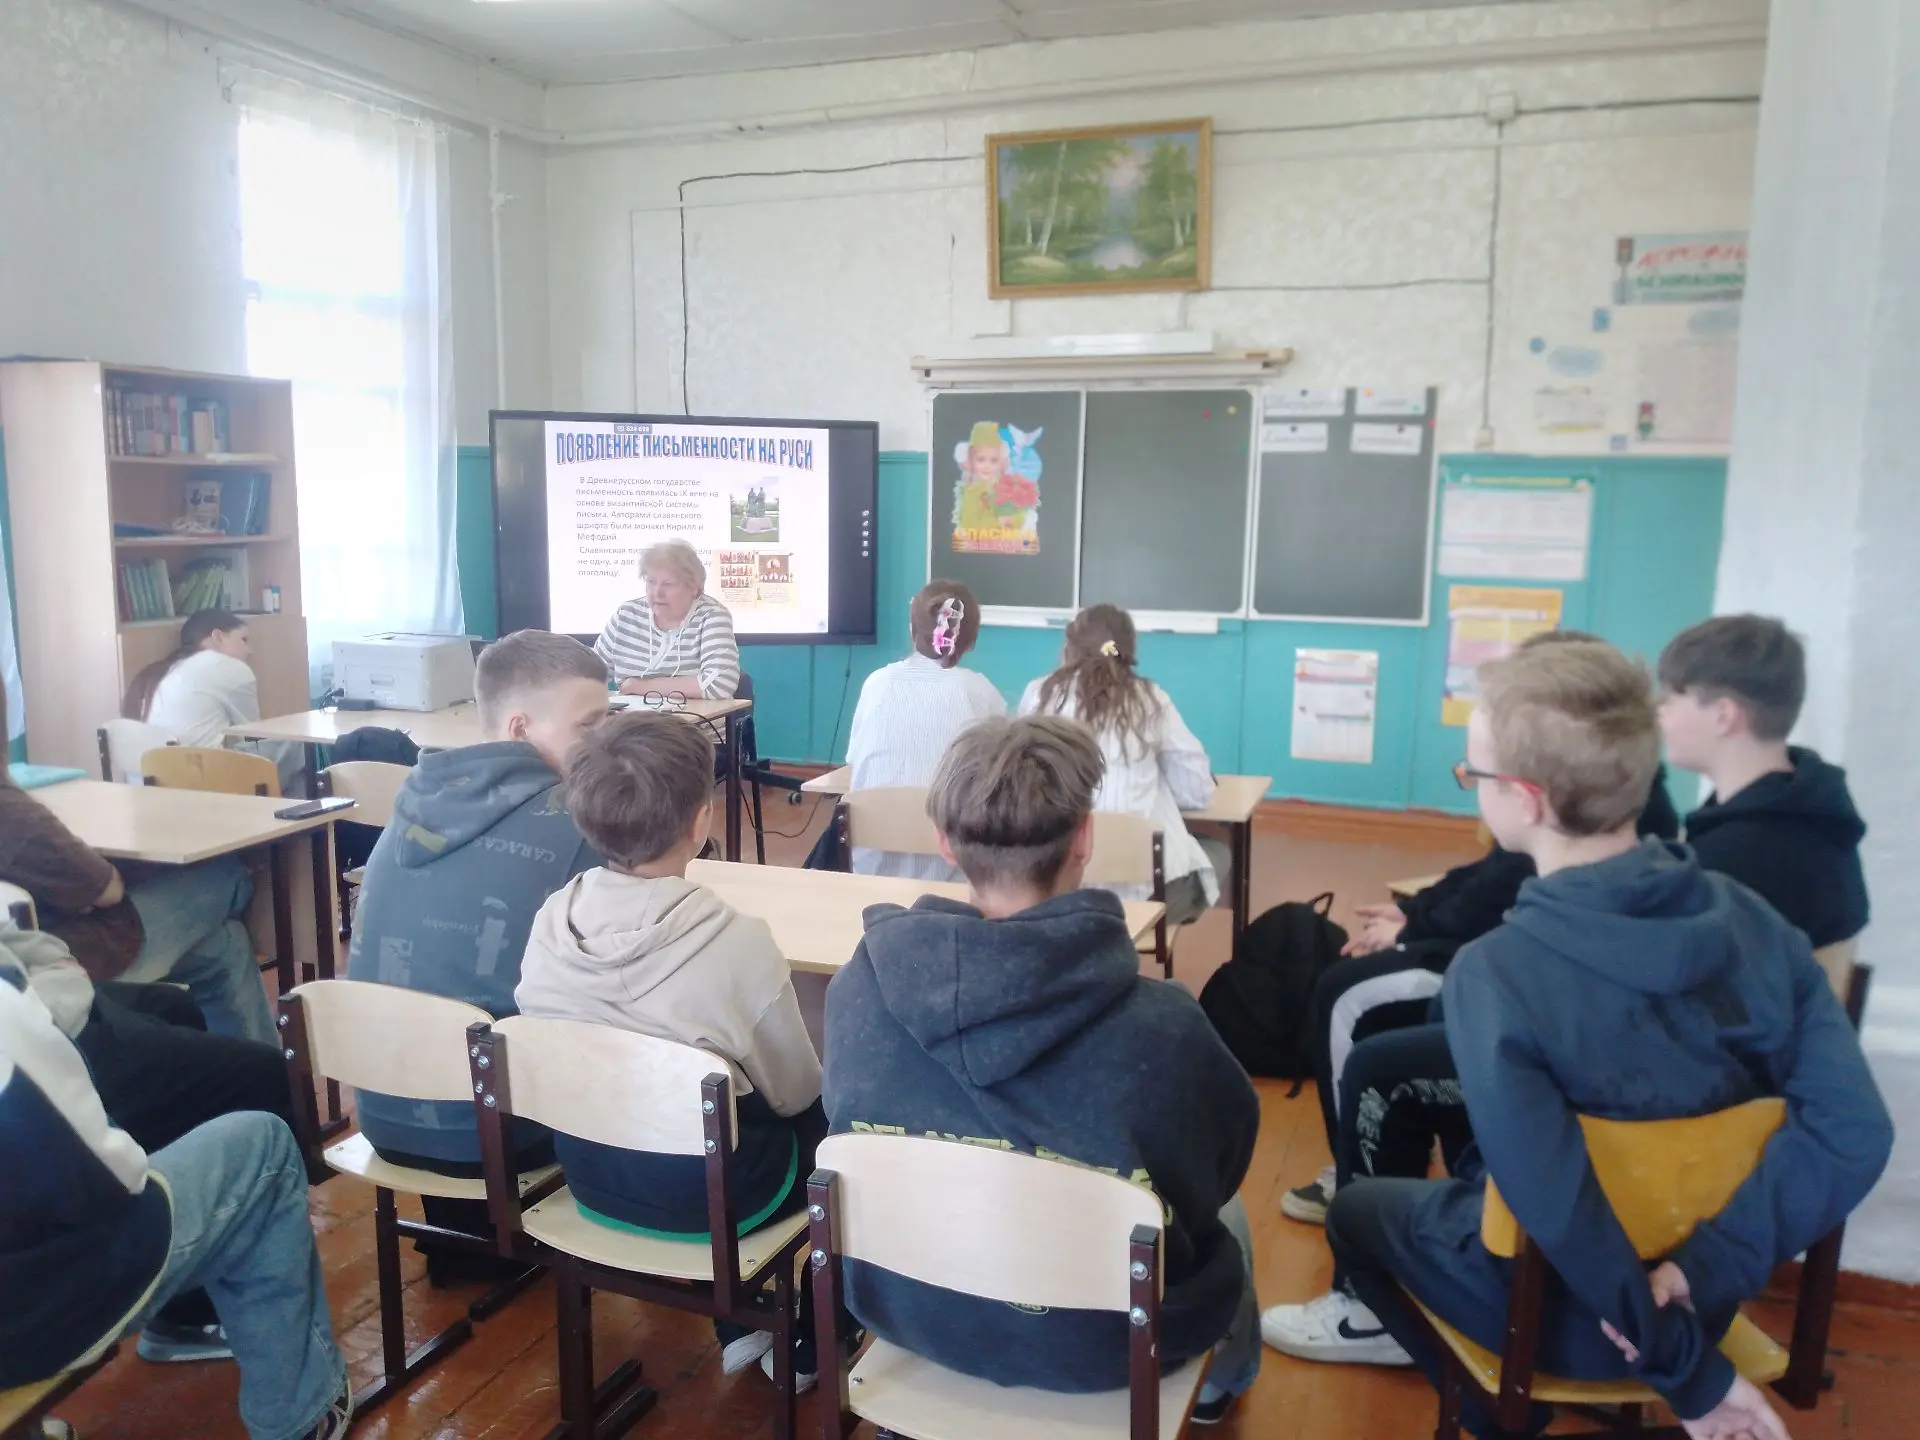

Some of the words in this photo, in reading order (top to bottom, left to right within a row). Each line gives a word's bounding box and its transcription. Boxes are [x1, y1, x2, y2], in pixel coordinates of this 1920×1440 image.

[556, 432, 641, 465] ПОЯВЛЕНИЕ
[642, 434, 756, 462] ПИСЬМЕННОСТИ
[758, 437, 777, 464] НА
[779, 438, 814, 471] РУСИ
[607, 499, 663, 508] византийской
[611, 511, 651, 520] Авторами
[610, 521, 632, 529] были
